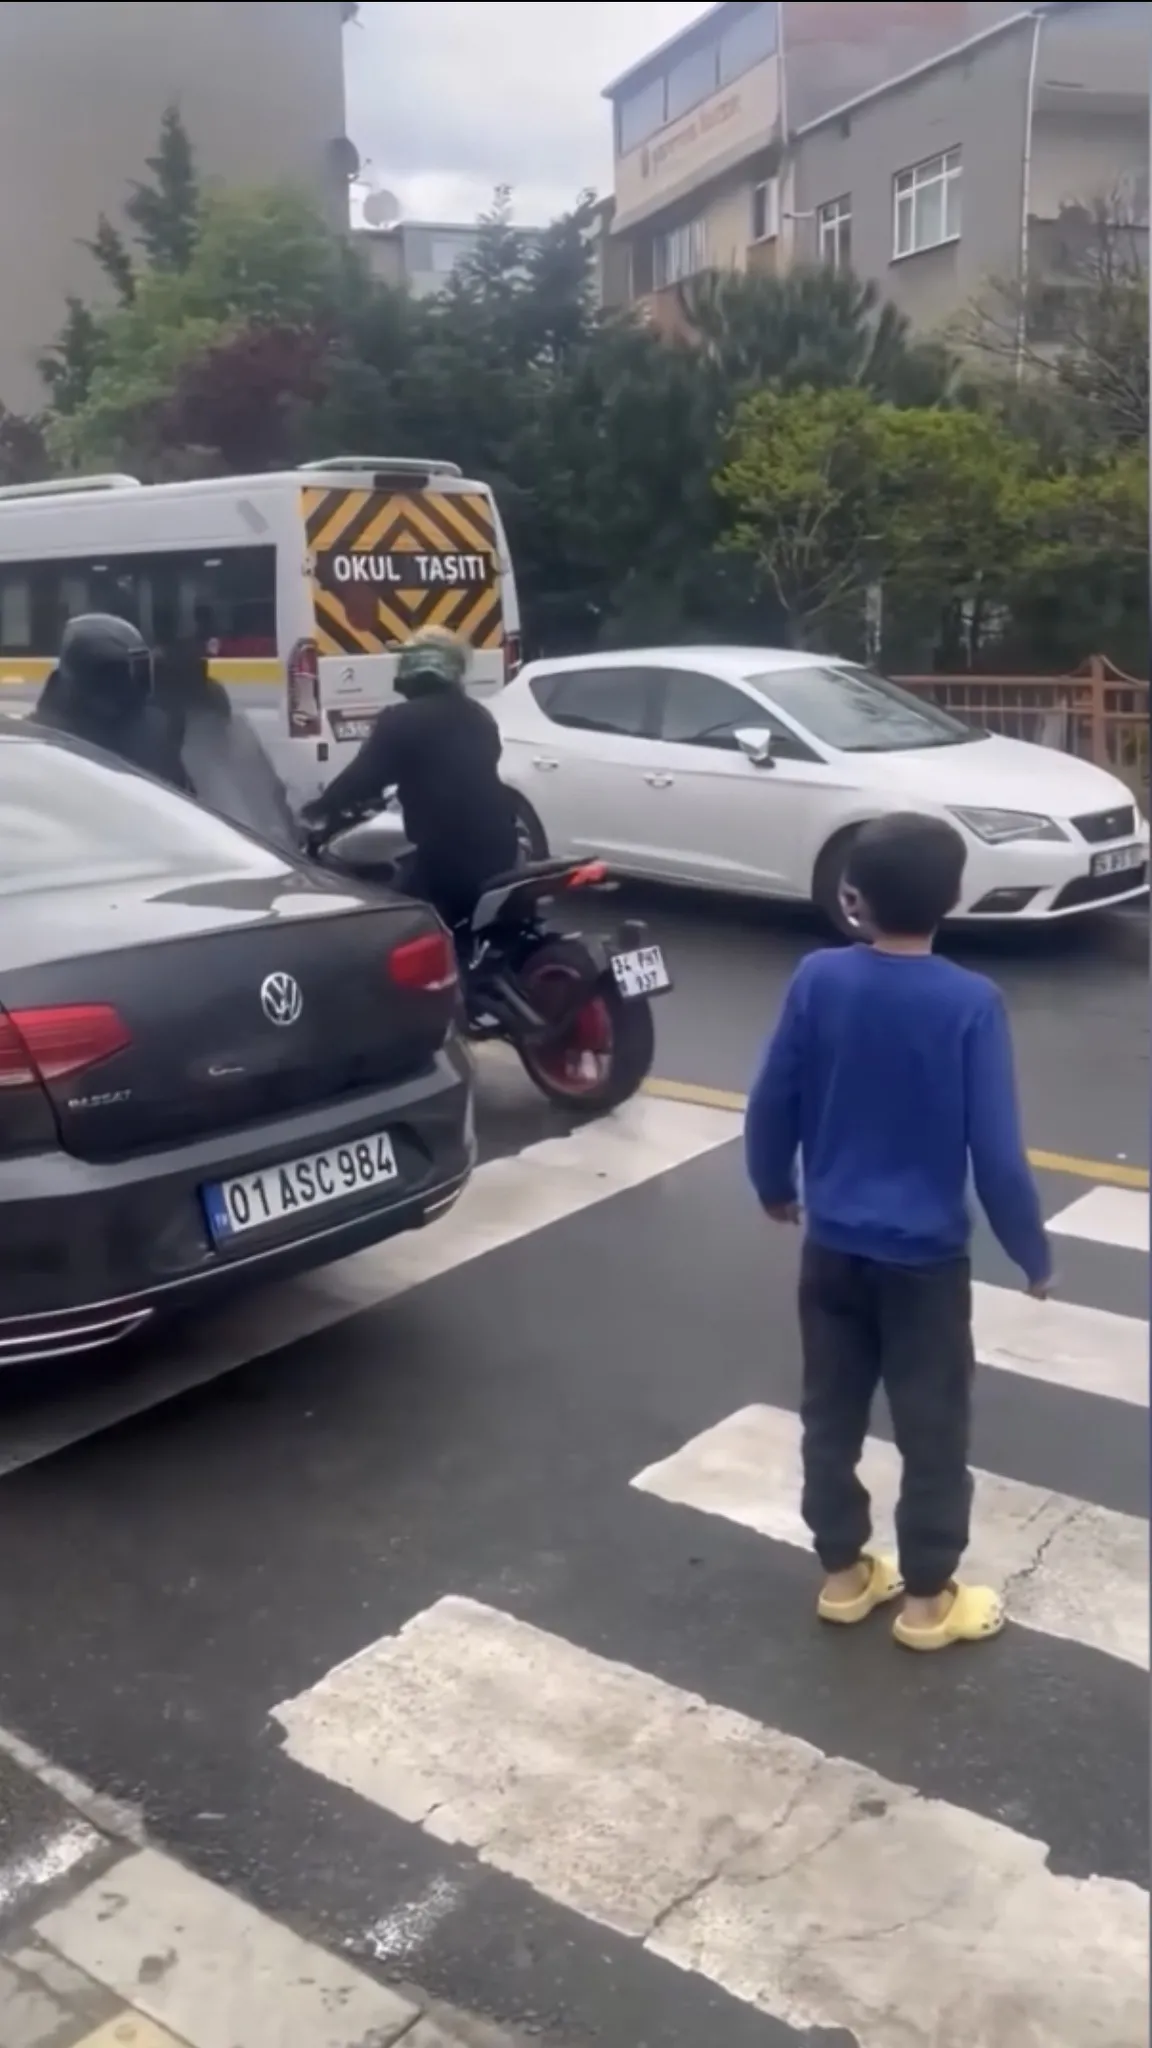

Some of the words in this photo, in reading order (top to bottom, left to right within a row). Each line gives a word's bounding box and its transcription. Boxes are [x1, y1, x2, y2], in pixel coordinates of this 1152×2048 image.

[333, 555, 401, 581] OKUL
[415, 555, 486, 585] TAŞITI
[229, 1176, 271, 1225] 01
[278, 1156, 335, 1211] ASC
[337, 1136, 393, 1187] 984
